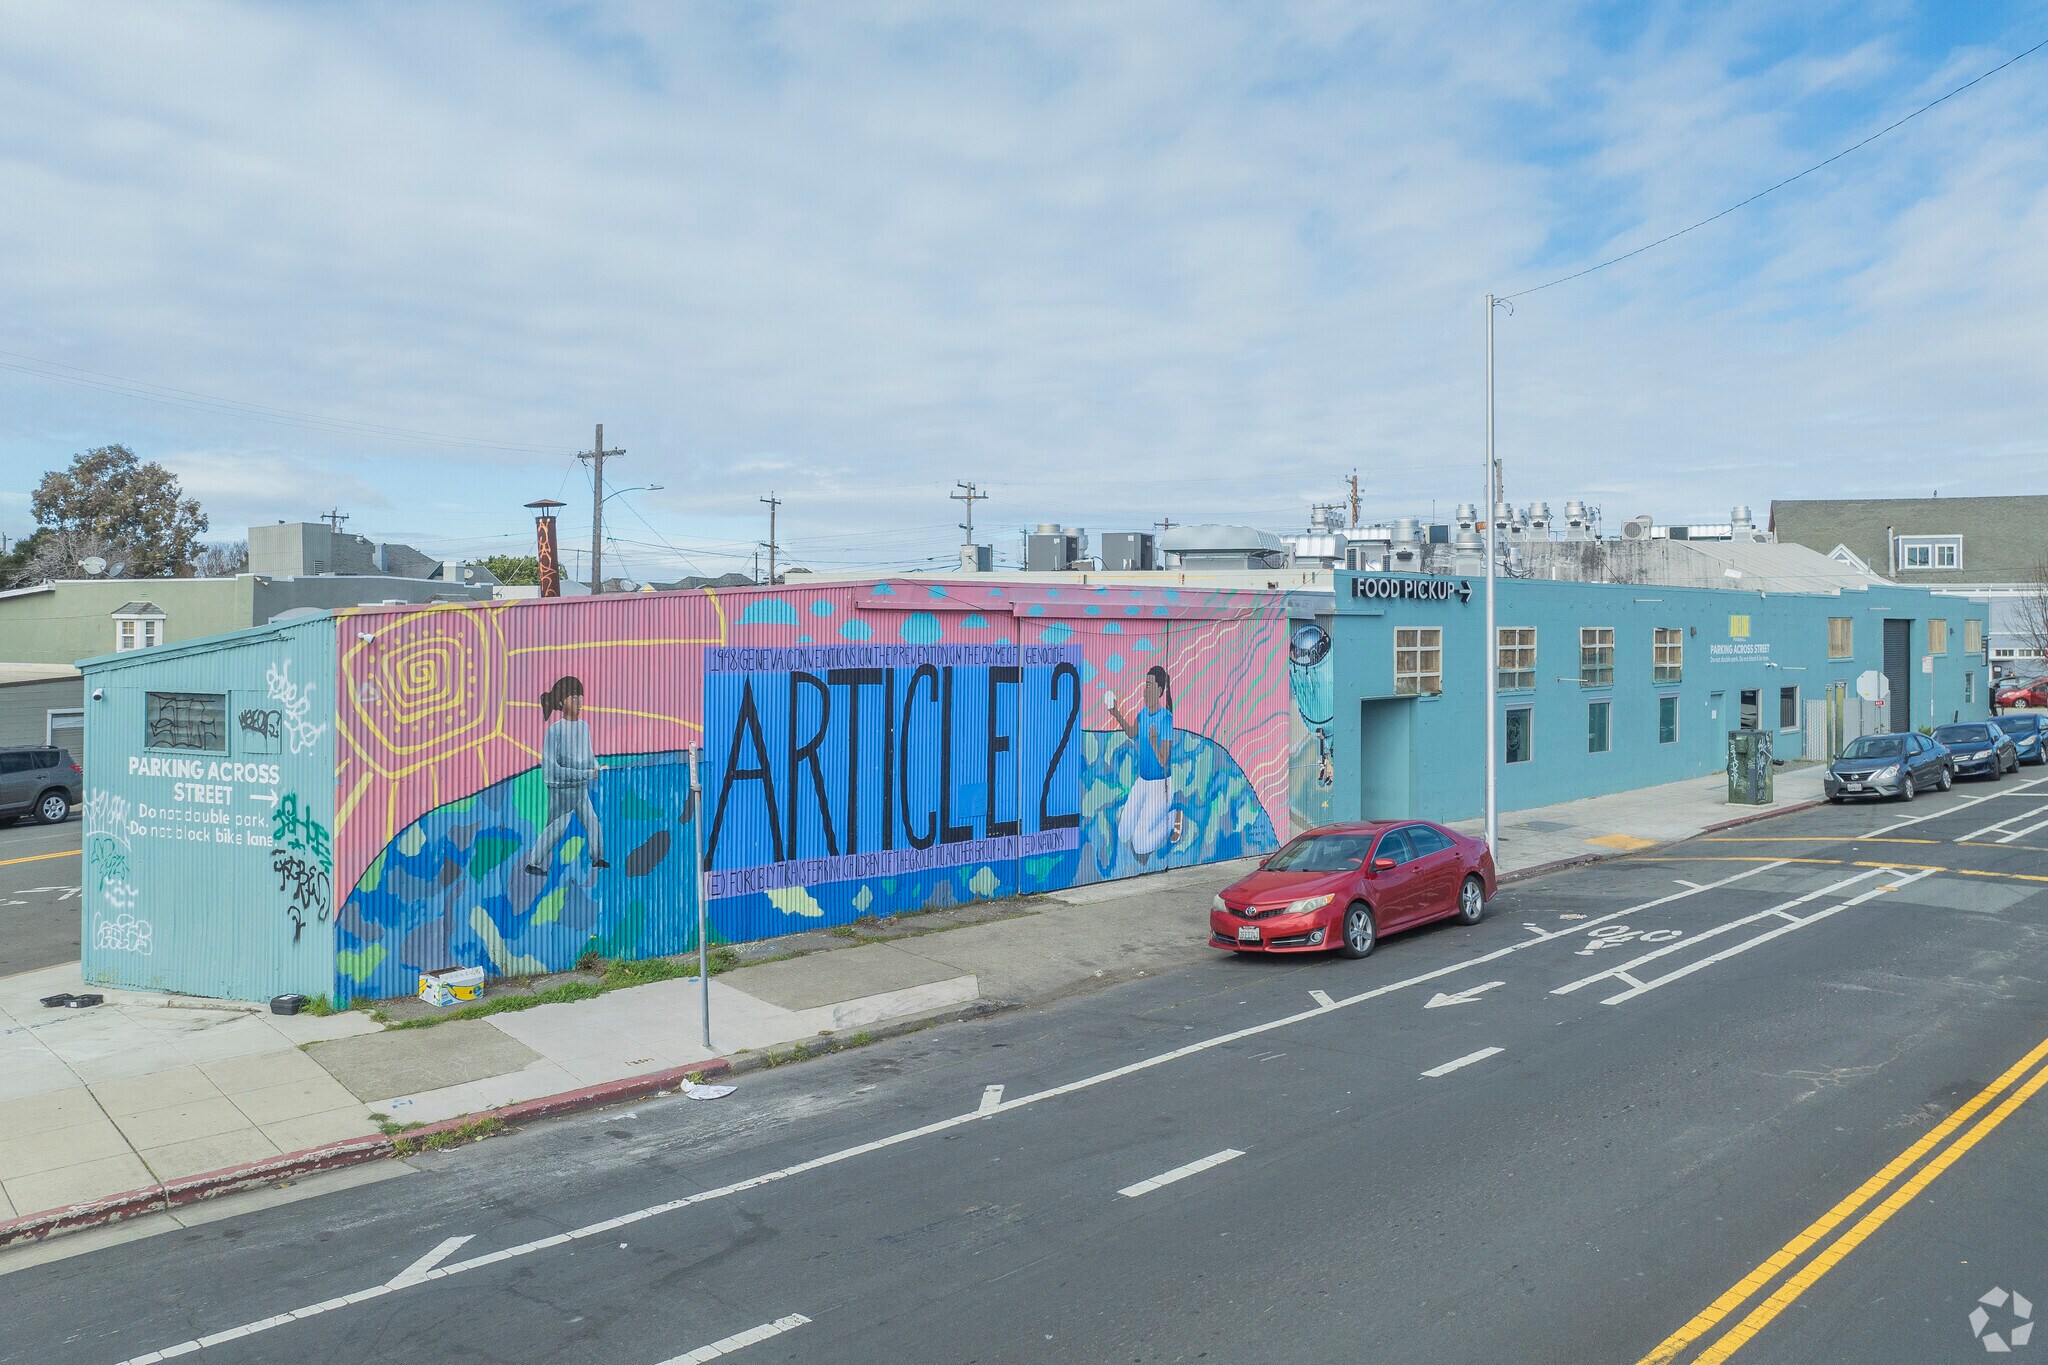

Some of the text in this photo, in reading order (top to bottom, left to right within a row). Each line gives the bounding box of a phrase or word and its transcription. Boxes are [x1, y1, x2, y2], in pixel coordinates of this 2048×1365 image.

[1356, 577, 1456, 600] FOOD PICKUP
[711, 648, 738, 672] 1948
[740, 648, 784, 671] GENEVA
[787, 647, 856, 671] CONVENTIONS
[860, 647, 872, 667] ON
[874, 646, 892, 666] THE
[964, 646, 979, 665] THE
[982, 646, 1006, 664] CRIME
[1007, 646, 1018, 664] OF
[1710, 643, 1770, 655] PARKING ACROSS STREET
[129, 756, 281, 785] PARKING ACROSS
[704, 662, 1081, 872] ARTICLE 2
[173, 782, 233, 806] STREET
[139, 803, 269, 829] Do not double park.
[130, 820, 279, 848] Do not block bike lane.
[843, 853, 880, 878] CHILDREN
[882, 852, 893, 873] OF
[894, 850, 910, 873] THE
[910, 847, 934, 872] GROUP
[936, 845, 945, 866] TO
[945, 842, 974, 864] ANOTHER
[1037, 831, 1065, 852] NATIONS
